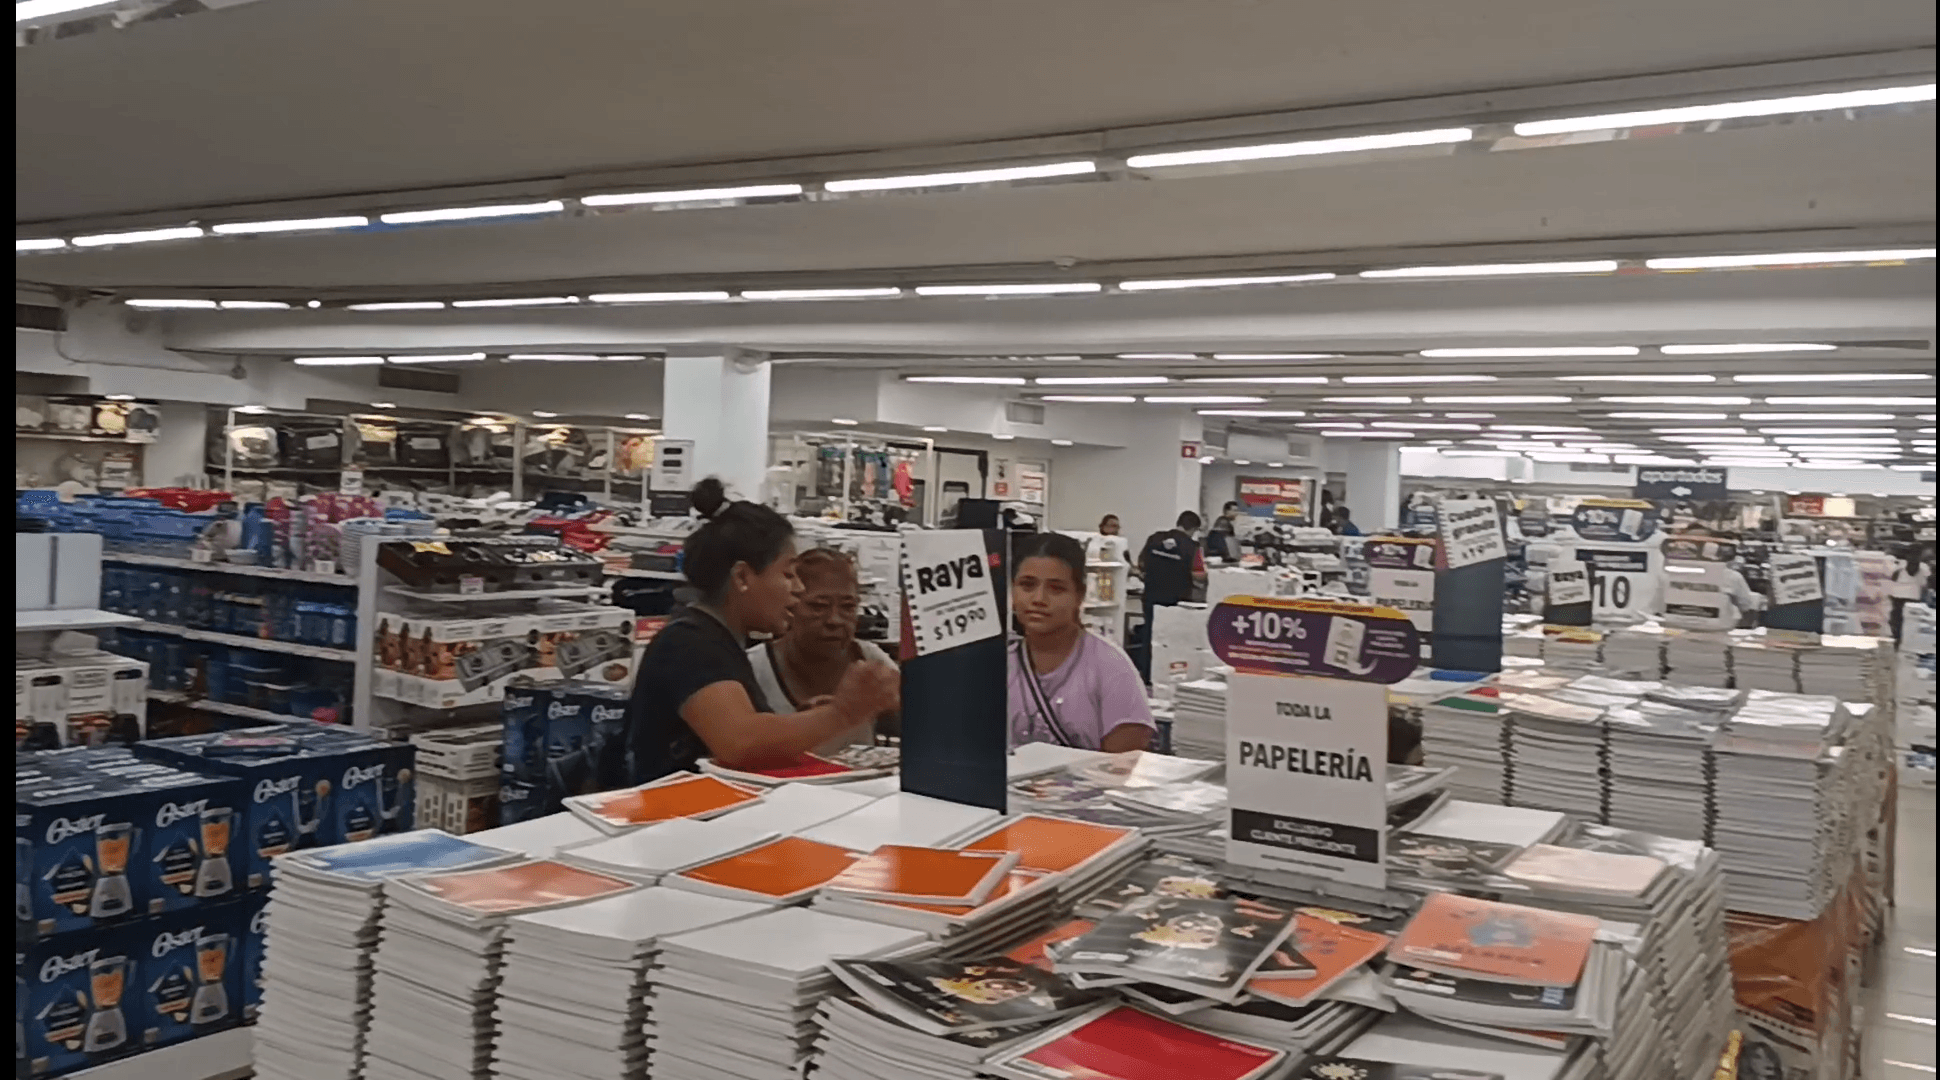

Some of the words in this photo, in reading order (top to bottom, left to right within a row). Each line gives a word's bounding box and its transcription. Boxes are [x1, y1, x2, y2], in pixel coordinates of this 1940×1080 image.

[917, 554, 984, 595] Raya
[1231, 611, 1308, 640] +10%
[1275, 701, 1312, 718] TODA
[1314, 707, 1332, 721] LA
[1239, 741, 1373, 782] PAPELERÍA
